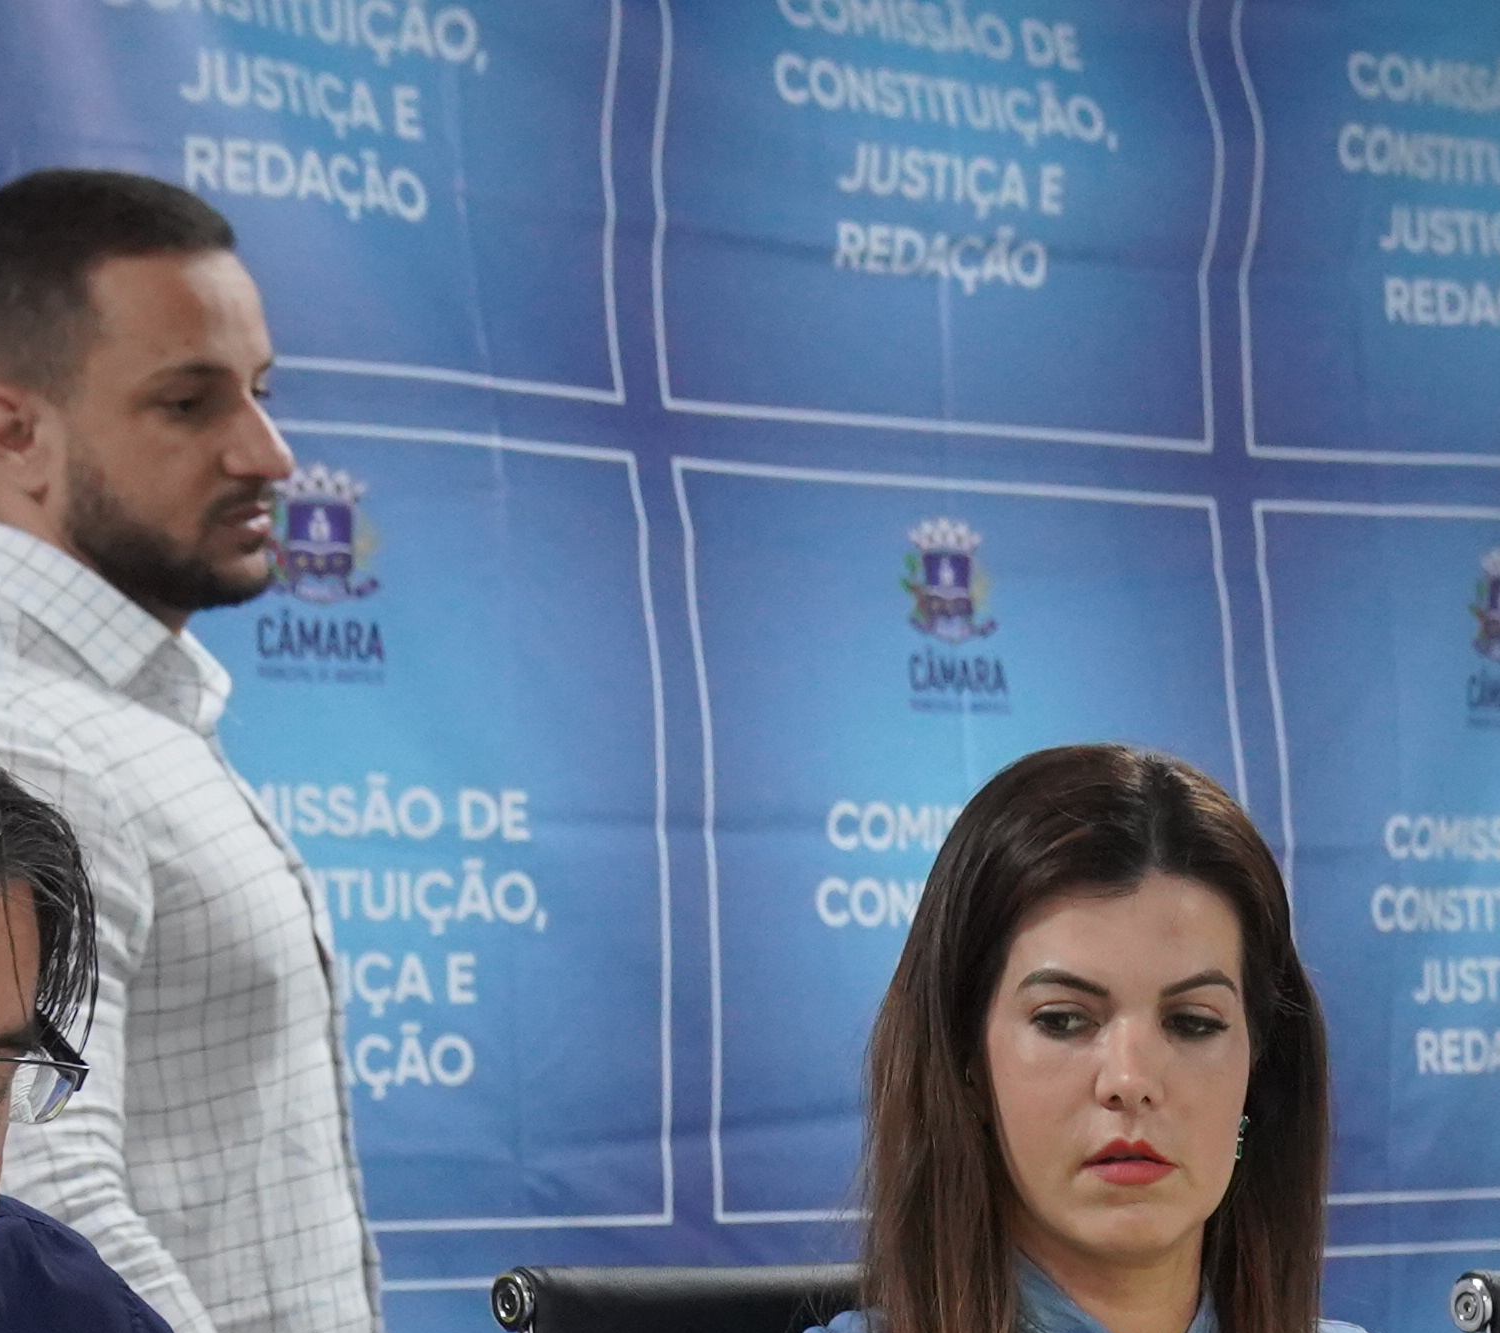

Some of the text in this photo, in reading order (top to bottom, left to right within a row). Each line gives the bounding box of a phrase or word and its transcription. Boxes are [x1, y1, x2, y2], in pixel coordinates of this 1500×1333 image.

[1019, 17, 1084, 72] DE
[179, 47, 425, 141] JUSTIÇA E
[773, 51, 1119, 152] CONSTITUIÇÃO,
[183, 134, 428, 222] REDAÇÃO
[837, 141, 1066, 220] JUSTIÇA E
[833, 218, 1049, 296] REDAÇÃO
[257, 607, 386, 662] CÂMARA
[908, 645, 1009, 696] CÂMARA
[458, 789, 530, 841] DE
[827, 801, 963, 851] COMI
[447, 953, 477, 1004] E
